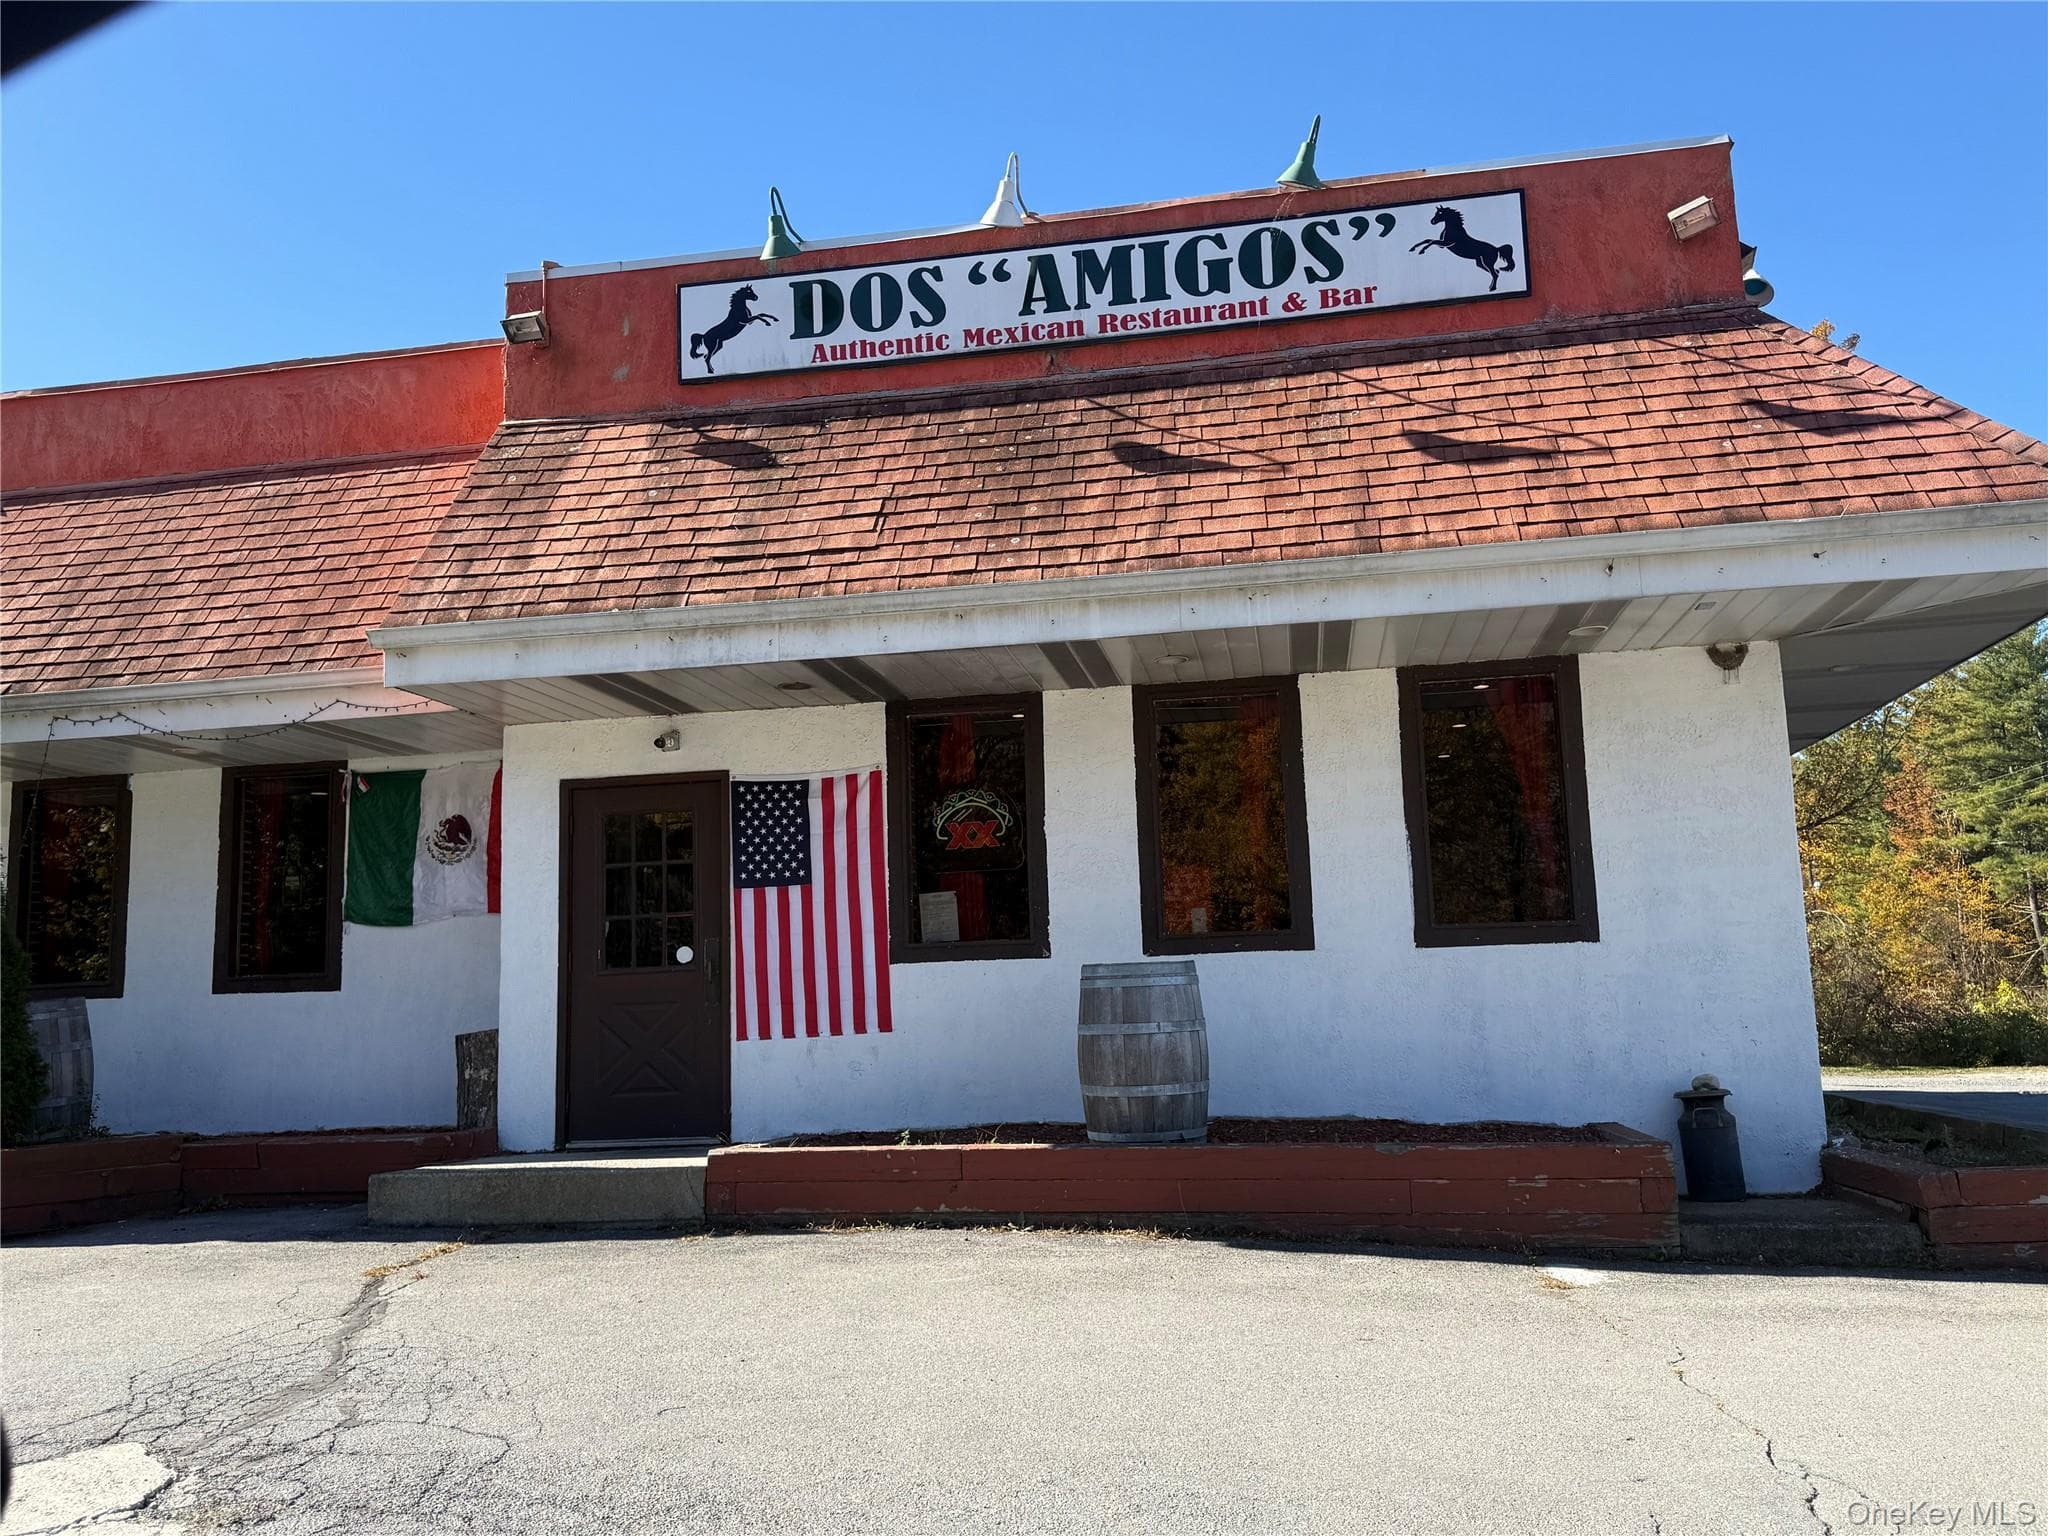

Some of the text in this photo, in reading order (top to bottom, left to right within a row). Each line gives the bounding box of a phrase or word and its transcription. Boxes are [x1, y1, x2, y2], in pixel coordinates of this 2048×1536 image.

[788, 265, 947, 340] DOS
[811, 284, 1379, 364] Authentic Mexican Restaurant & Bar
[946, 820, 1000, 850] XX
